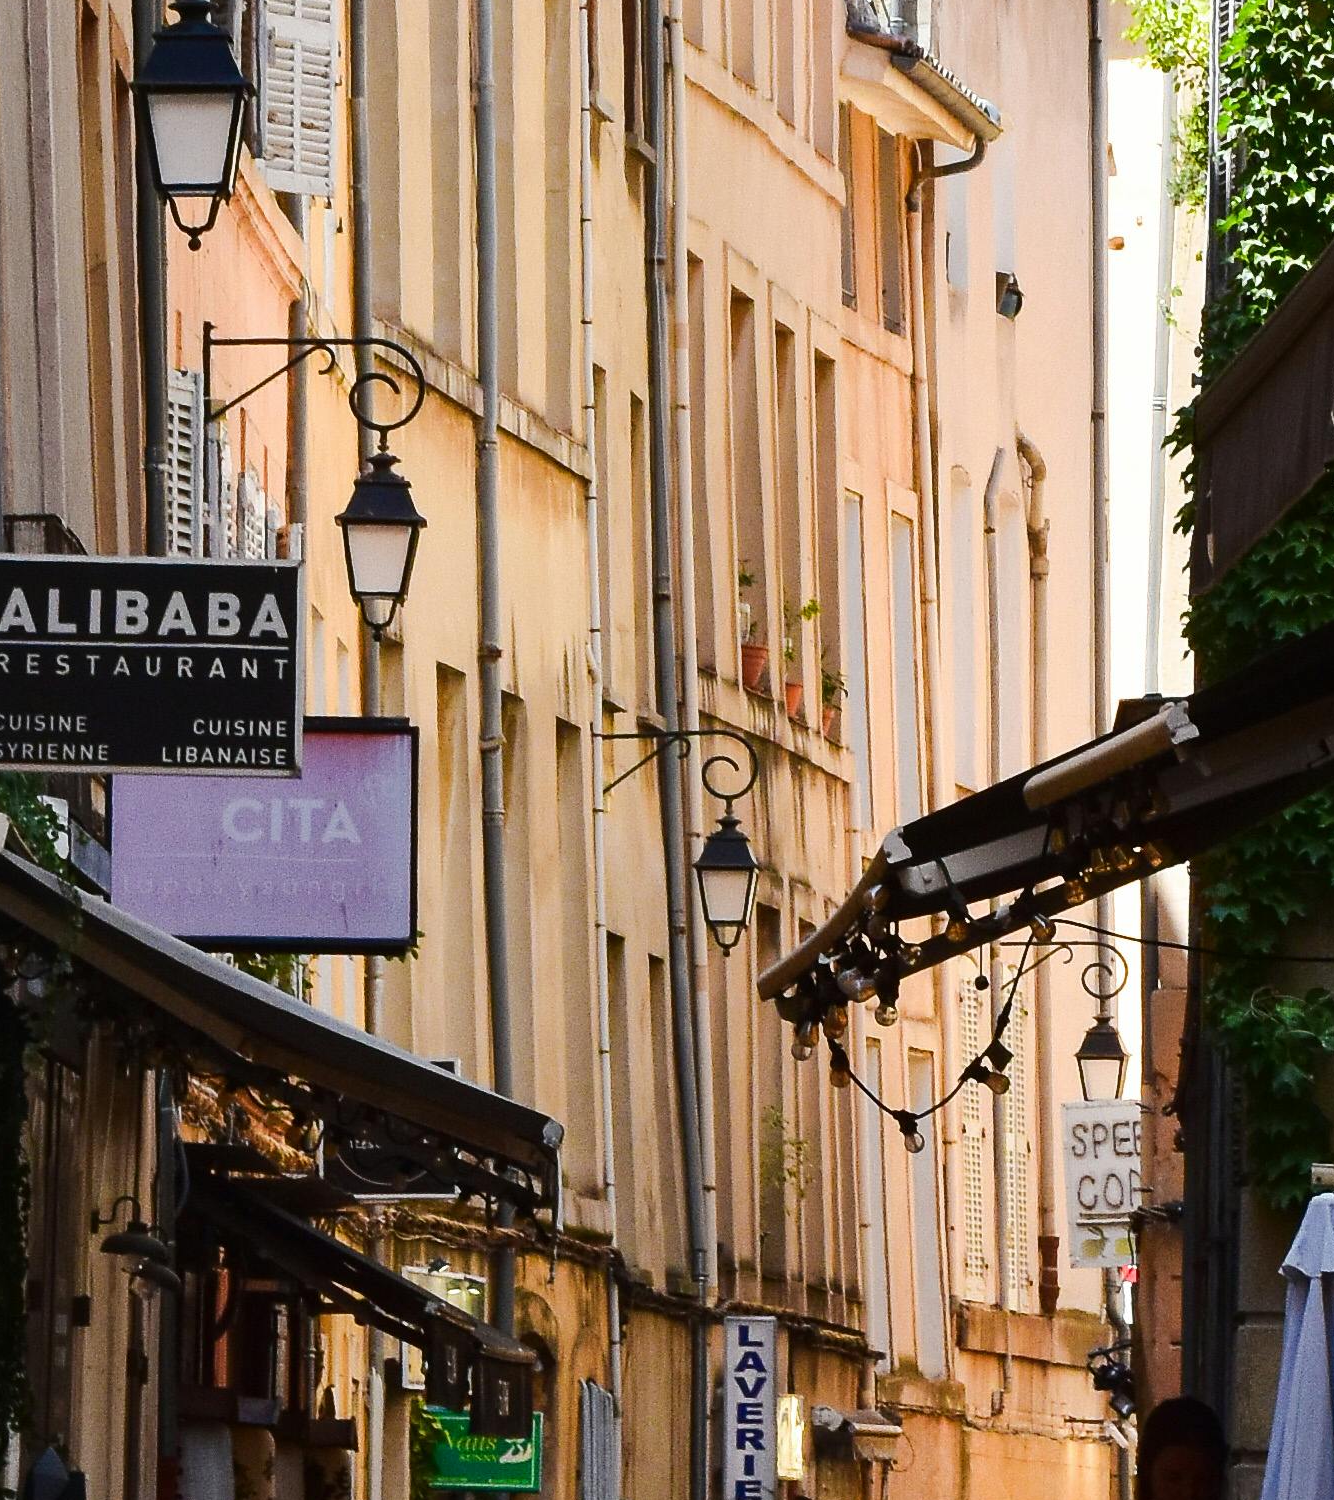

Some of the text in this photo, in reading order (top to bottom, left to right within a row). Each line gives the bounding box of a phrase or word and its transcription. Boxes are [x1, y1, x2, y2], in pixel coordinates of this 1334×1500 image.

[193, 719, 288, 737] CUISINE
[162, 746, 287, 765] LIBANAISE
[222, 798, 363, 843] CITA
